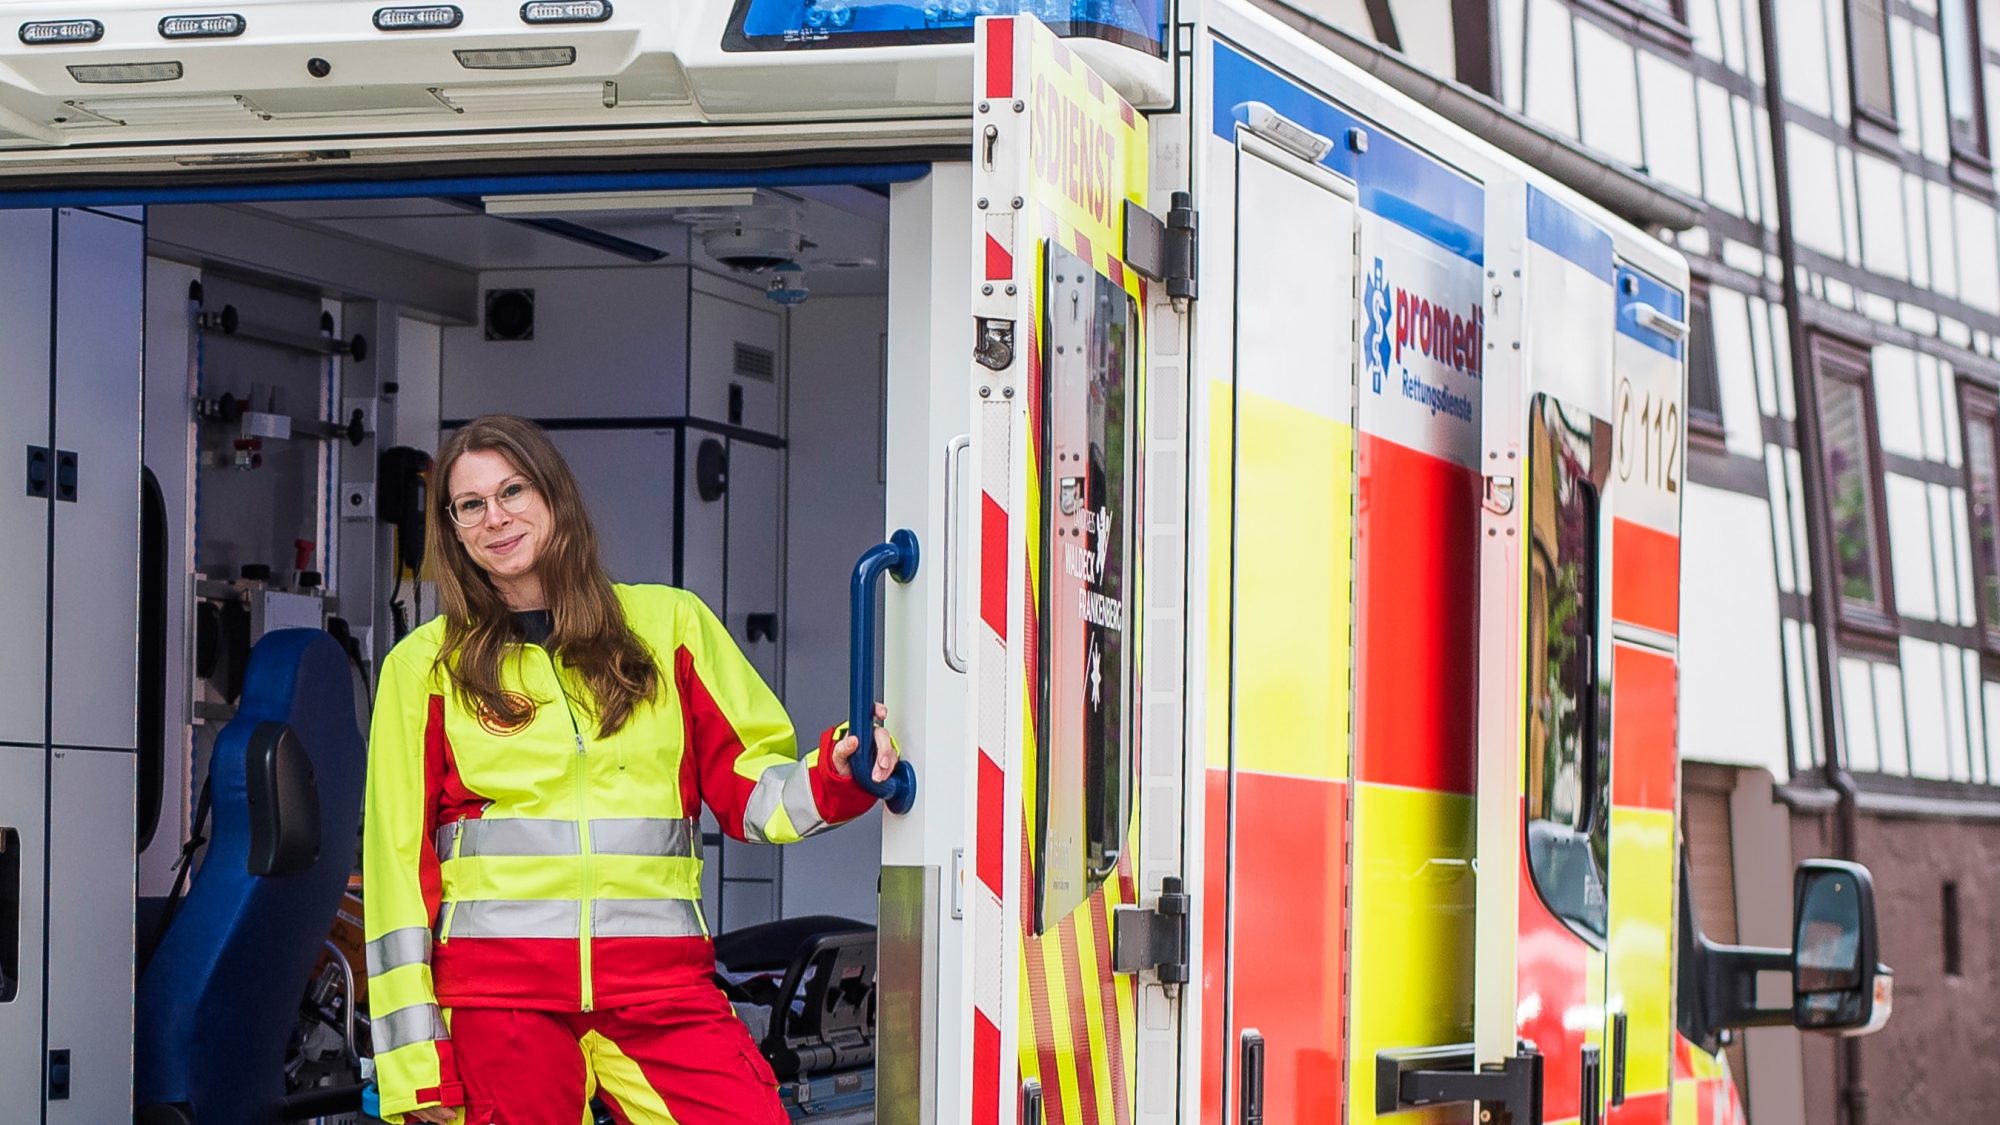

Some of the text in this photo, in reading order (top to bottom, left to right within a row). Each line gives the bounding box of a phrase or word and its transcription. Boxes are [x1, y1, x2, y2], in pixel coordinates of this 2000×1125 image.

[1030, 72, 1115, 229] SDIENST
[1395, 286, 1484, 380] promedi
[1641, 388, 1678, 493] 112
[1065, 541, 1096, 584] WALDECK
[1079, 587, 1121, 631] FRANKENBERG
